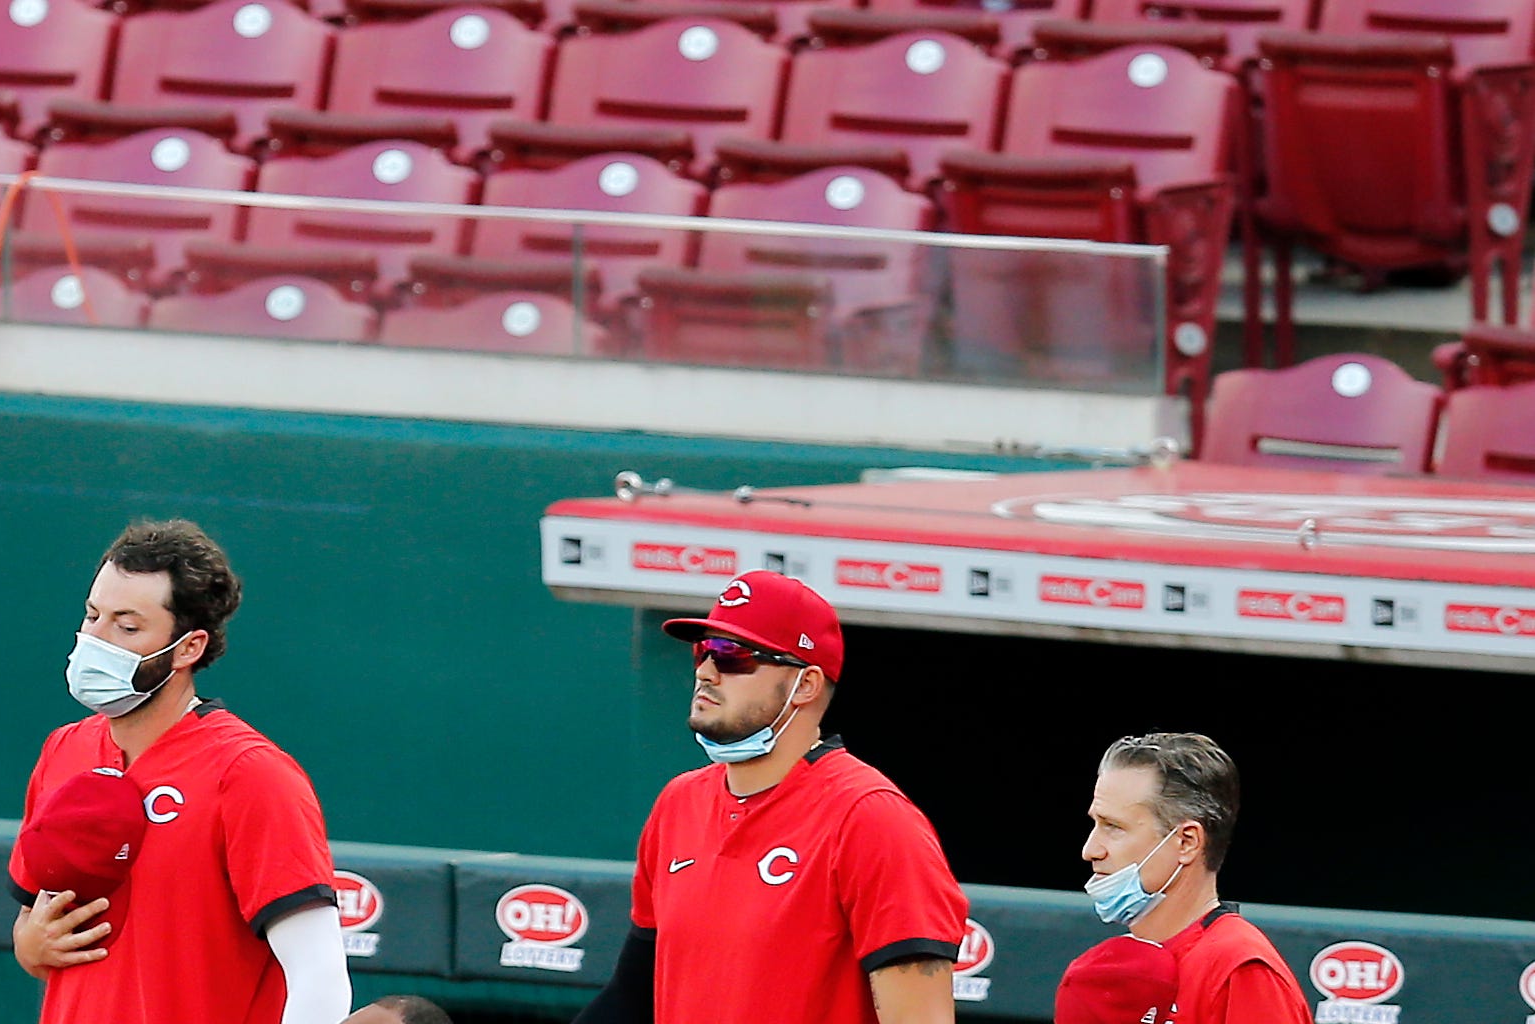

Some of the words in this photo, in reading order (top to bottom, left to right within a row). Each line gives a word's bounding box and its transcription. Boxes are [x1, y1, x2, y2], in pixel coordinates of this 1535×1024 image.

[143, 785, 185, 824] C
[757, 846, 799, 886] C
[505, 899, 578, 933] OH!
[1317, 957, 1393, 990] OH!
